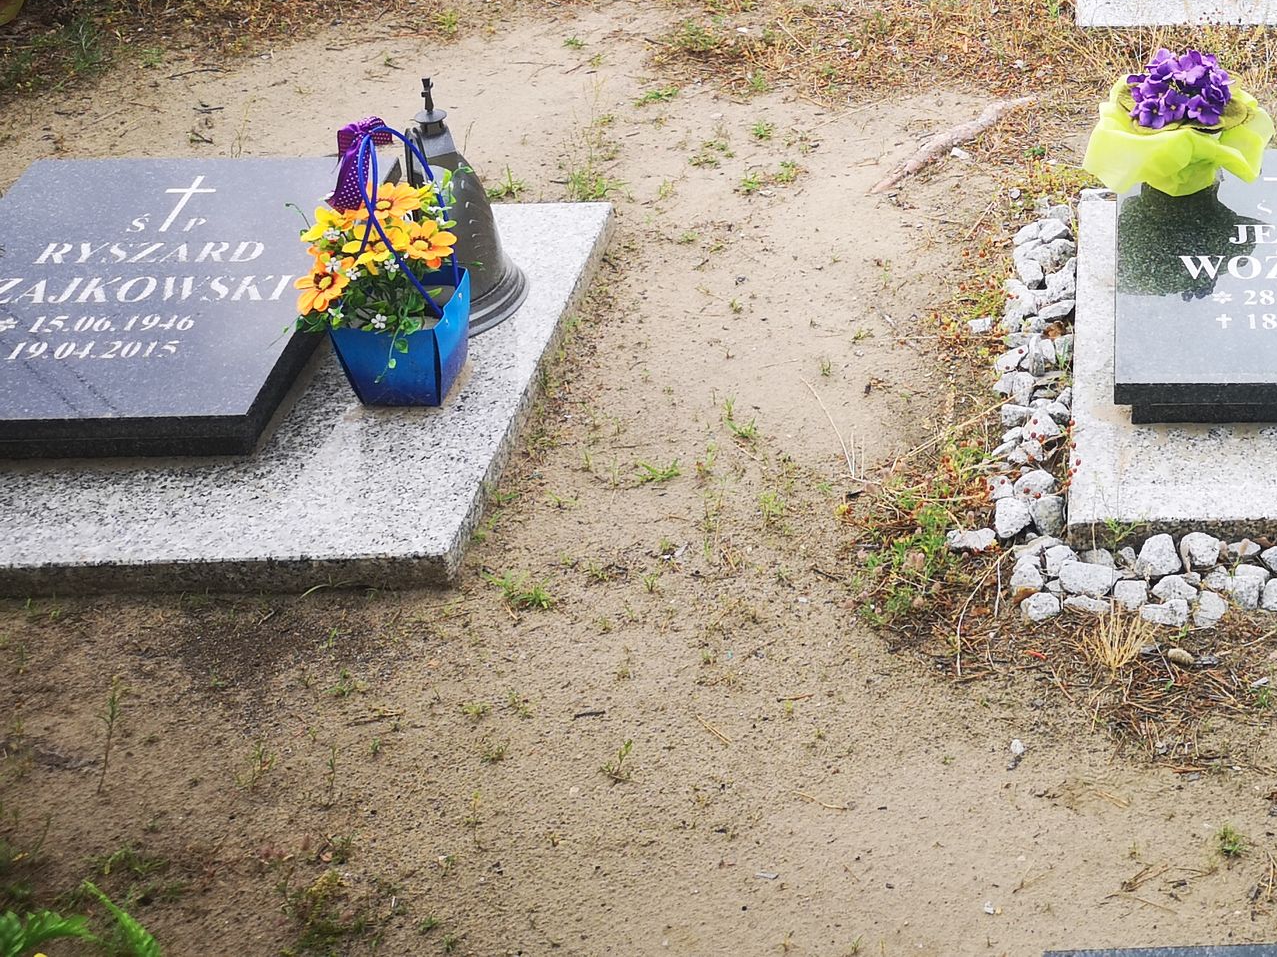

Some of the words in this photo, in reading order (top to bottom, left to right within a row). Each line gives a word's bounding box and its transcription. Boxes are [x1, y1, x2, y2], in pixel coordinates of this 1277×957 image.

[32, 241, 266, 266] RYSZARD
[28, 313, 196, 335] 15.06.1946
[4, 339, 182, 361] 19.04.2015
